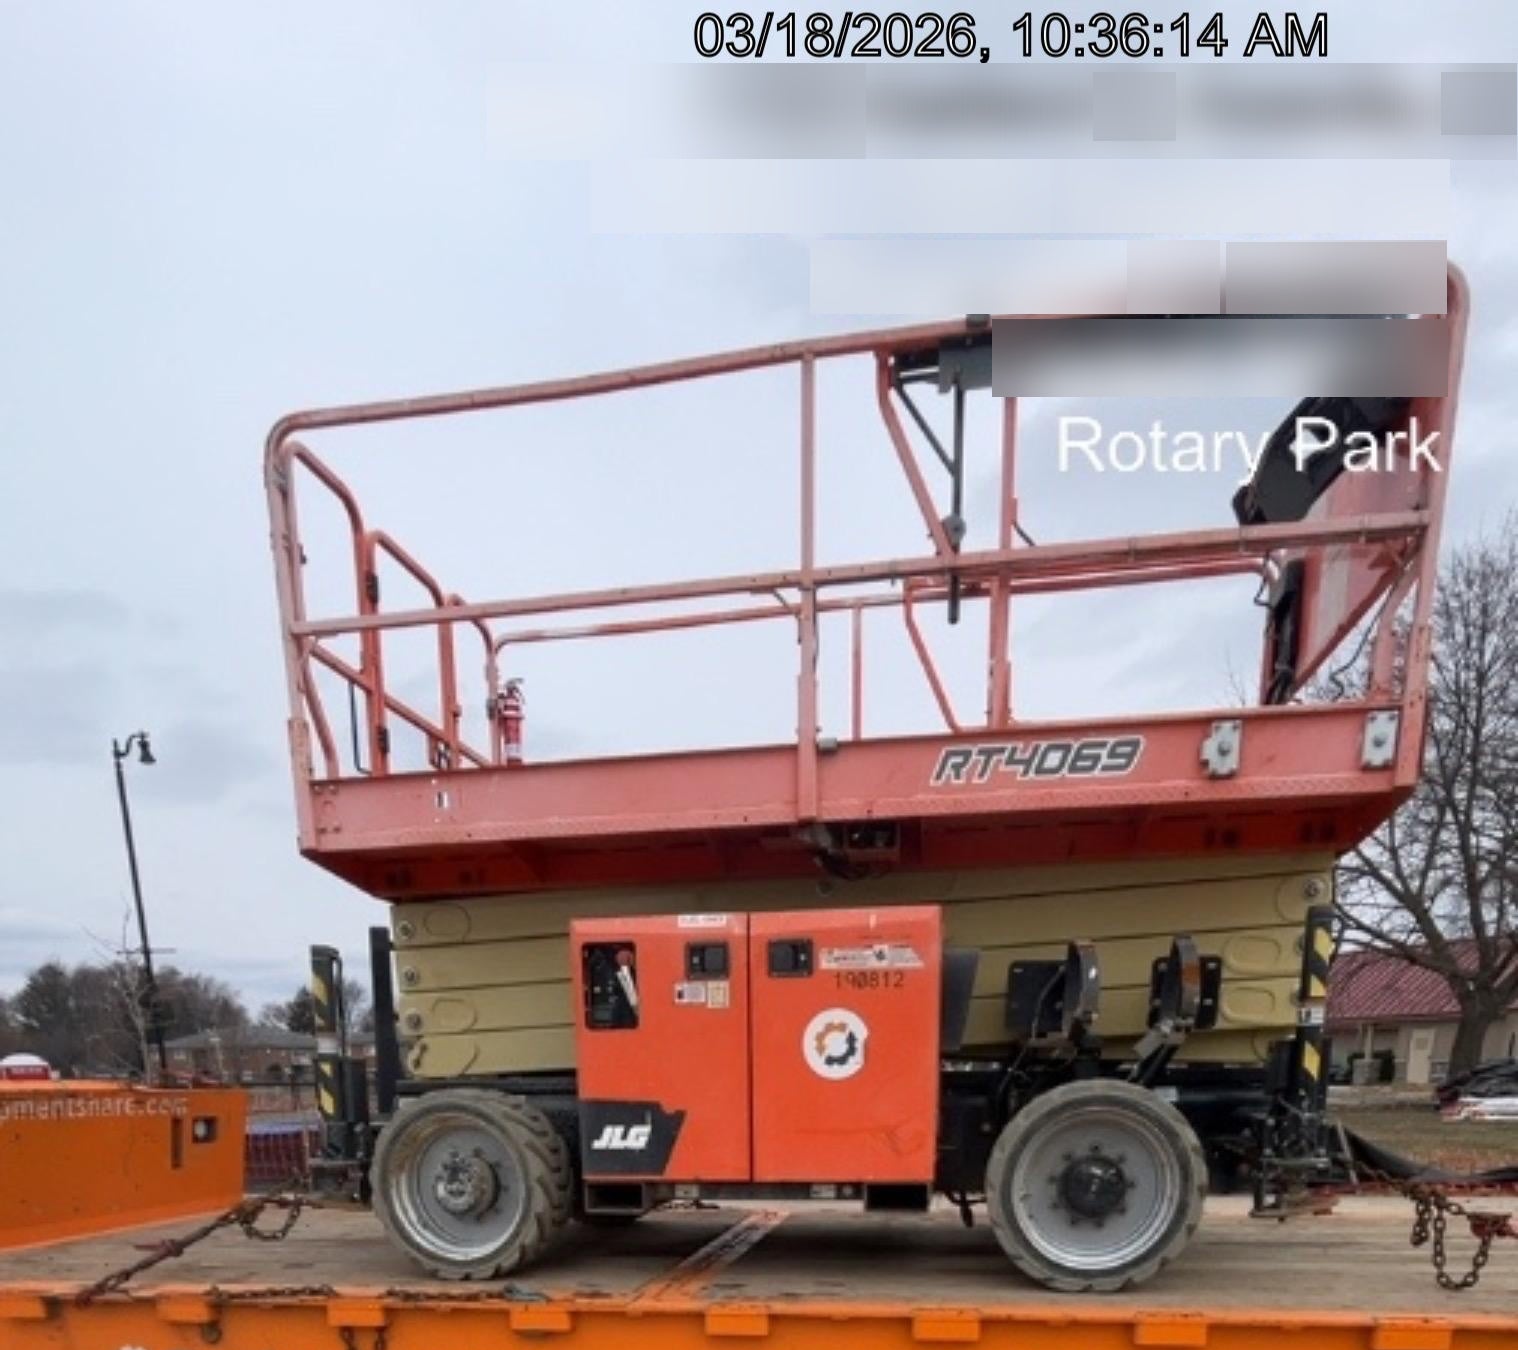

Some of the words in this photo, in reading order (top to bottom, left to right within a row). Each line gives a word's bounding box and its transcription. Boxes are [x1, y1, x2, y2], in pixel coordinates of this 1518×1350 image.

[931, 735, 1145, 786] RT4069
[834, 971, 905, 990] 190812
[592, 1125, 651, 1149] JLG
